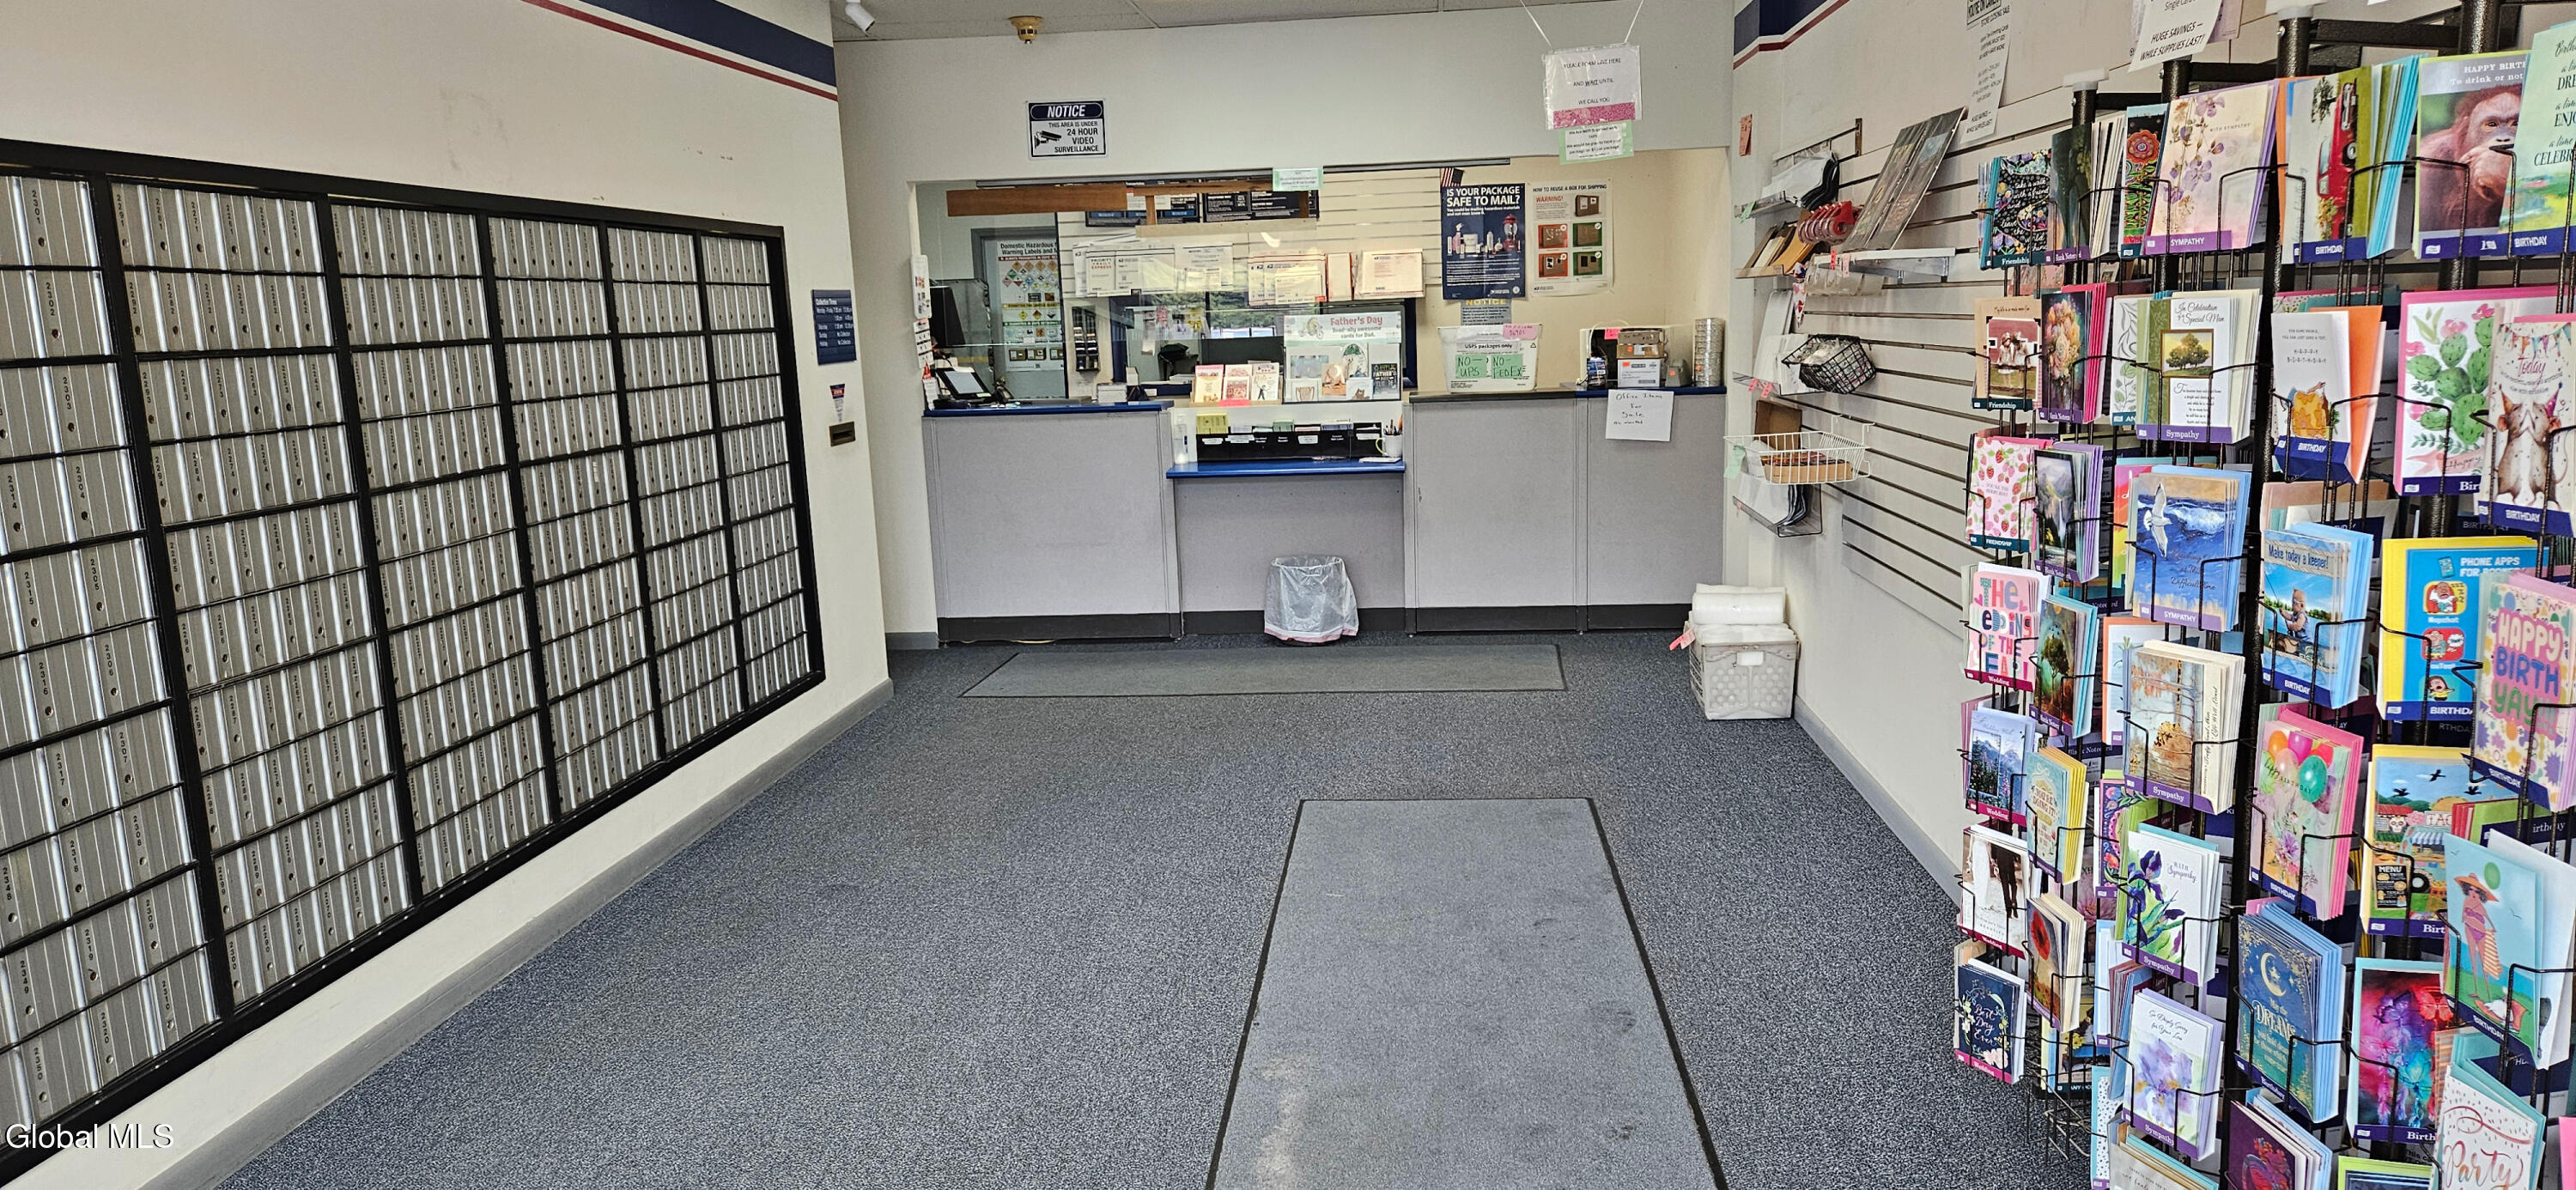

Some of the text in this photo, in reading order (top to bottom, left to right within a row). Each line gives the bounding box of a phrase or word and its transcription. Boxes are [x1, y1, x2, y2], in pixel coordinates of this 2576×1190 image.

[2151, 21, 2196, 44] HUGE SAVINGS
[2140, 33, 2205, 61] WHILE SUPPLIES LAST!
[2464, 64, 2496, 74] HAPPY
[2465, 76, 2492, 84] drink
[1048, 105, 1085, 118] NOTICE
[2534, 149, 2574, 167] CELEBR
[1455, 187, 1479, 196] YOUR
[1480, 186, 1520, 195] PACKAGE
[2014, 180, 2027, 189] take
[2032, 186, 2050, 197] friend
[32, 190, 40, 224] 2301
[1447, 195, 1521, 207] SAFE TO MAIL?
[2171, 237, 2204, 246] SYMPATHY
[2514, 234, 2547, 247] BIRTHDAY
[46, 282, 55, 315] 2302
[2175, 302, 2217, 314] In Celebration
[1330, 316, 1382, 325] Father's Day
[2183, 313, 2205, 325] Special
[1461, 367, 1479, 377] UPS
[2518, 357, 2547, 385] Today
[63, 377, 72, 410] 2303
[2166, 429, 2200, 440] Sympathy
[2298, 442, 2326, 452] BIRTHDAY
[155, 457, 164, 487] 2294
[76, 467, 85, 499] 2304
[2459, 481, 2480, 490] Bir
[8, 476, 17, 509] 2314
[2506, 510, 2540, 523] BIRTHDAY
[1985, 538, 2012, 547] FRIENDSHIP
[2269, 543, 2329, 571] Make today a keeper!
[2460, 556, 2520, 567] PHONE APPS
[90, 559, 100, 590] 2305
[2460, 568, 2480, 577] FOR
[24, 572, 34, 604] 2315
[2164, 610, 2196, 622] SYMPATHY
[2498, 612, 2561, 662] HAPPY
[105, 645, 114, 676] 2306
[39, 663, 49, 695] 2316
[2495, 646, 2559, 697] BIRTH
[1988, 676, 2009, 686] Wedding
[2284, 679, 2311, 695] BIRTHDAY
[119, 732, 128, 763] 2307
[56, 753, 65, 786] 2317
[2035, 787, 2053, 804] YOU'RE
[2153, 786, 2184, 802] Sympathy
[2032, 796, 2048, 813] DOING
[1986, 807, 2008, 820] Wedding
[133, 816, 143, 846] 2308
[70, 841, 79, 872] 2318
[2166, 865, 2196, 883] Sympathy
[2173, 862, 2189, 871] WITH
[3, 867, 12, 900] 2348
[2270, 883, 2296, 901] BIRTHDAY
[145, 900, 154, 930] 2309
[2422, 925, 2445, 933] Birt
[85, 929, 94, 961] 2319
[1982, 936, 2002, 950] Wedding
[2143, 956, 2175, 975] Sympathy
[20, 961, 29, 994] 2349
[1975, 1005, 1996, 1021] Best
[2269, 998, 2280, 1011] May
[1975, 1017, 1995, 1035] Day
[2252, 999, 2297, 1047] DREAMS
[1974, 1029, 1996, 1047] Ever
[1972, 1062, 1995, 1077] Wedding
[2261, 1077, 2285, 1100] Birthday
[2144, 1124, 2175, 1146] Sympathy
[2407, 1132, 2435, 1140] Birth
[2444, 1140, 2524, 1188] Party
